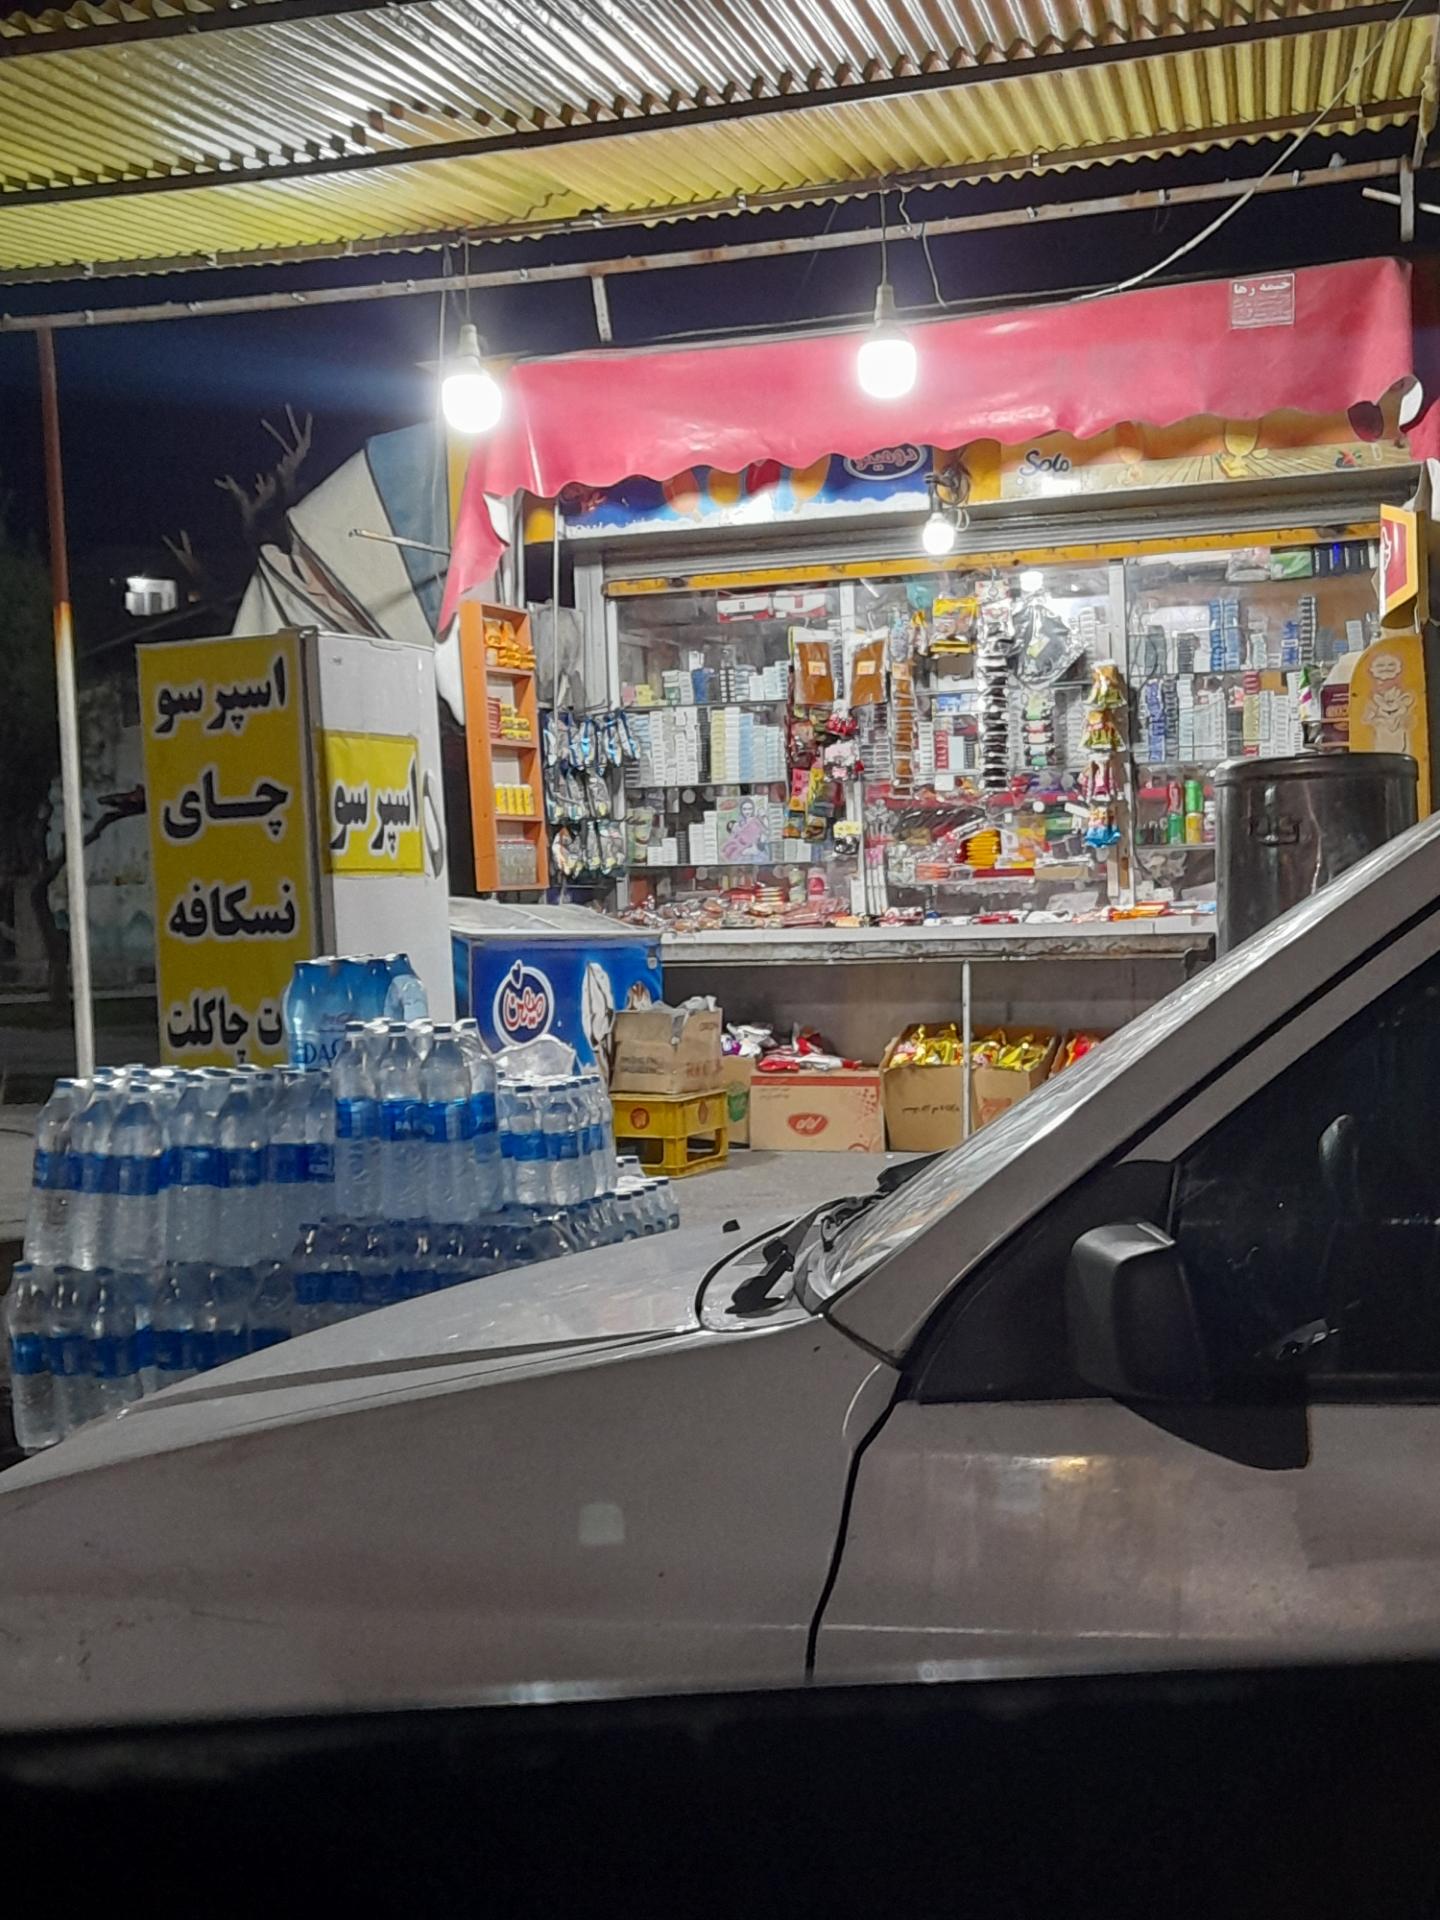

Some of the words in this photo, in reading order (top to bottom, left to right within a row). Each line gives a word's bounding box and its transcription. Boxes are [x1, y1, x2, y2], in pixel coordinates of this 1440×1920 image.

[1019, 449, 1071, 476] Solo
[163, 770, 289, 838] چای
[169, 883, 296, 937] نسکافه
